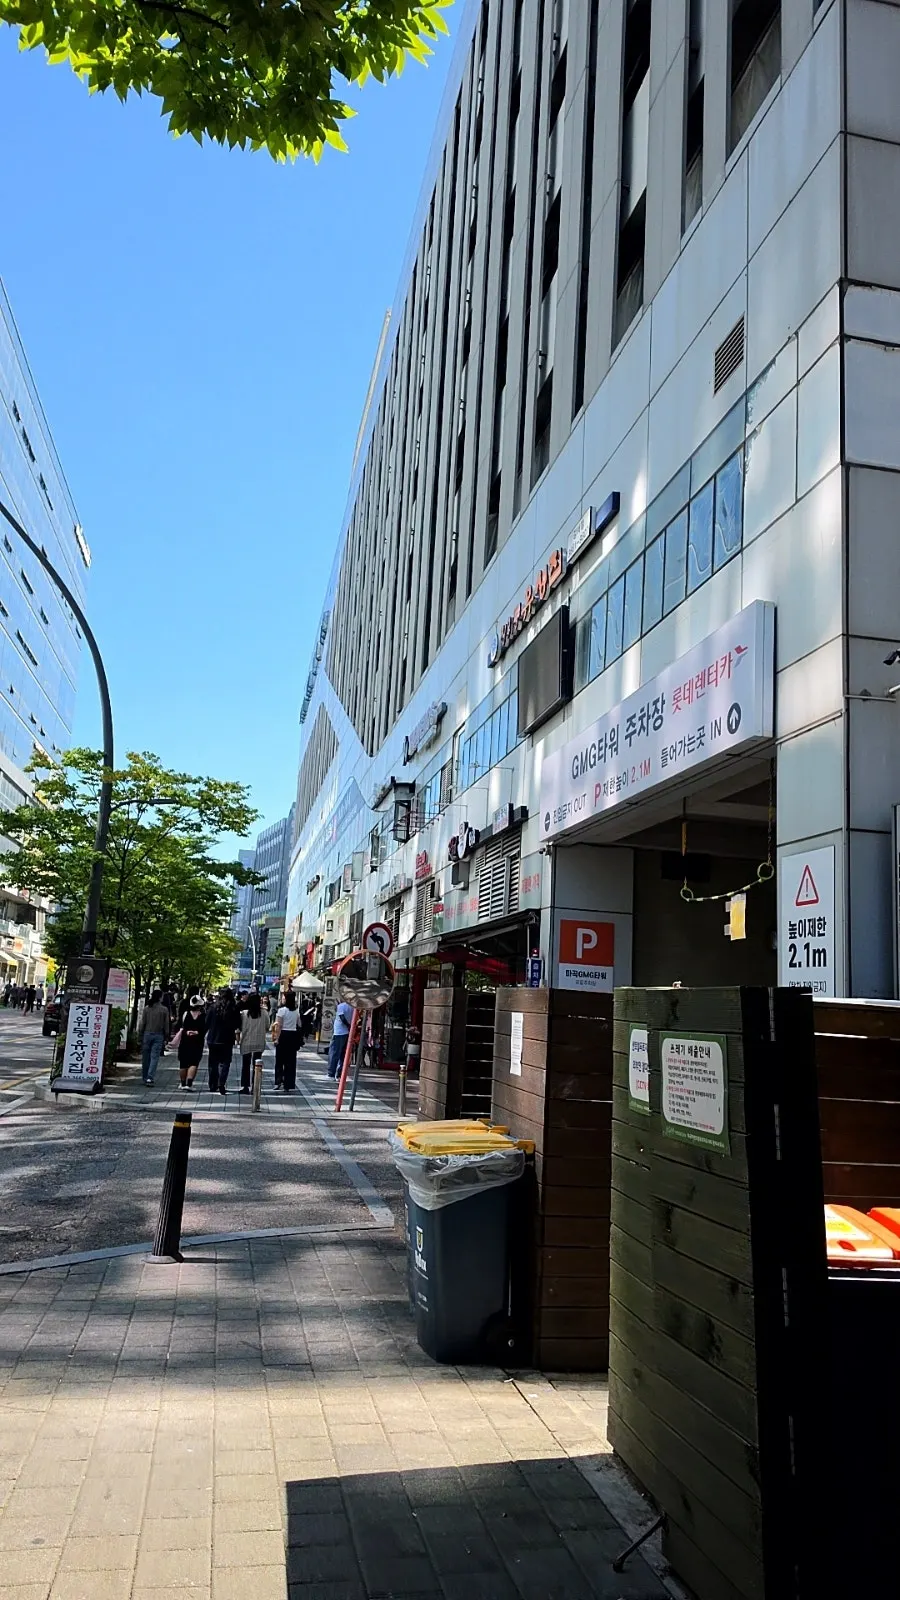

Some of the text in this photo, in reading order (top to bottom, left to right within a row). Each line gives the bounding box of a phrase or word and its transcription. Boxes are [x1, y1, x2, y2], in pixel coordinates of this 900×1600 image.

[572, 652, 733, 780] GMG타워 주차장 롯데렌터카
[660, 717, 722, 768] 들어가는곳 IN
[602, 770, 629, 797] 제한높이
[631, 757, 651, 783] 2.1M
[553, 792, 587, 824] 진입금지 OUT
[576, 928, 598, 959] P
[788, 916, 827, 940] 높이제한
[788, 942, 827, 968] 2.1m
[68, 1005, 92, 1074] 장위동유성집
